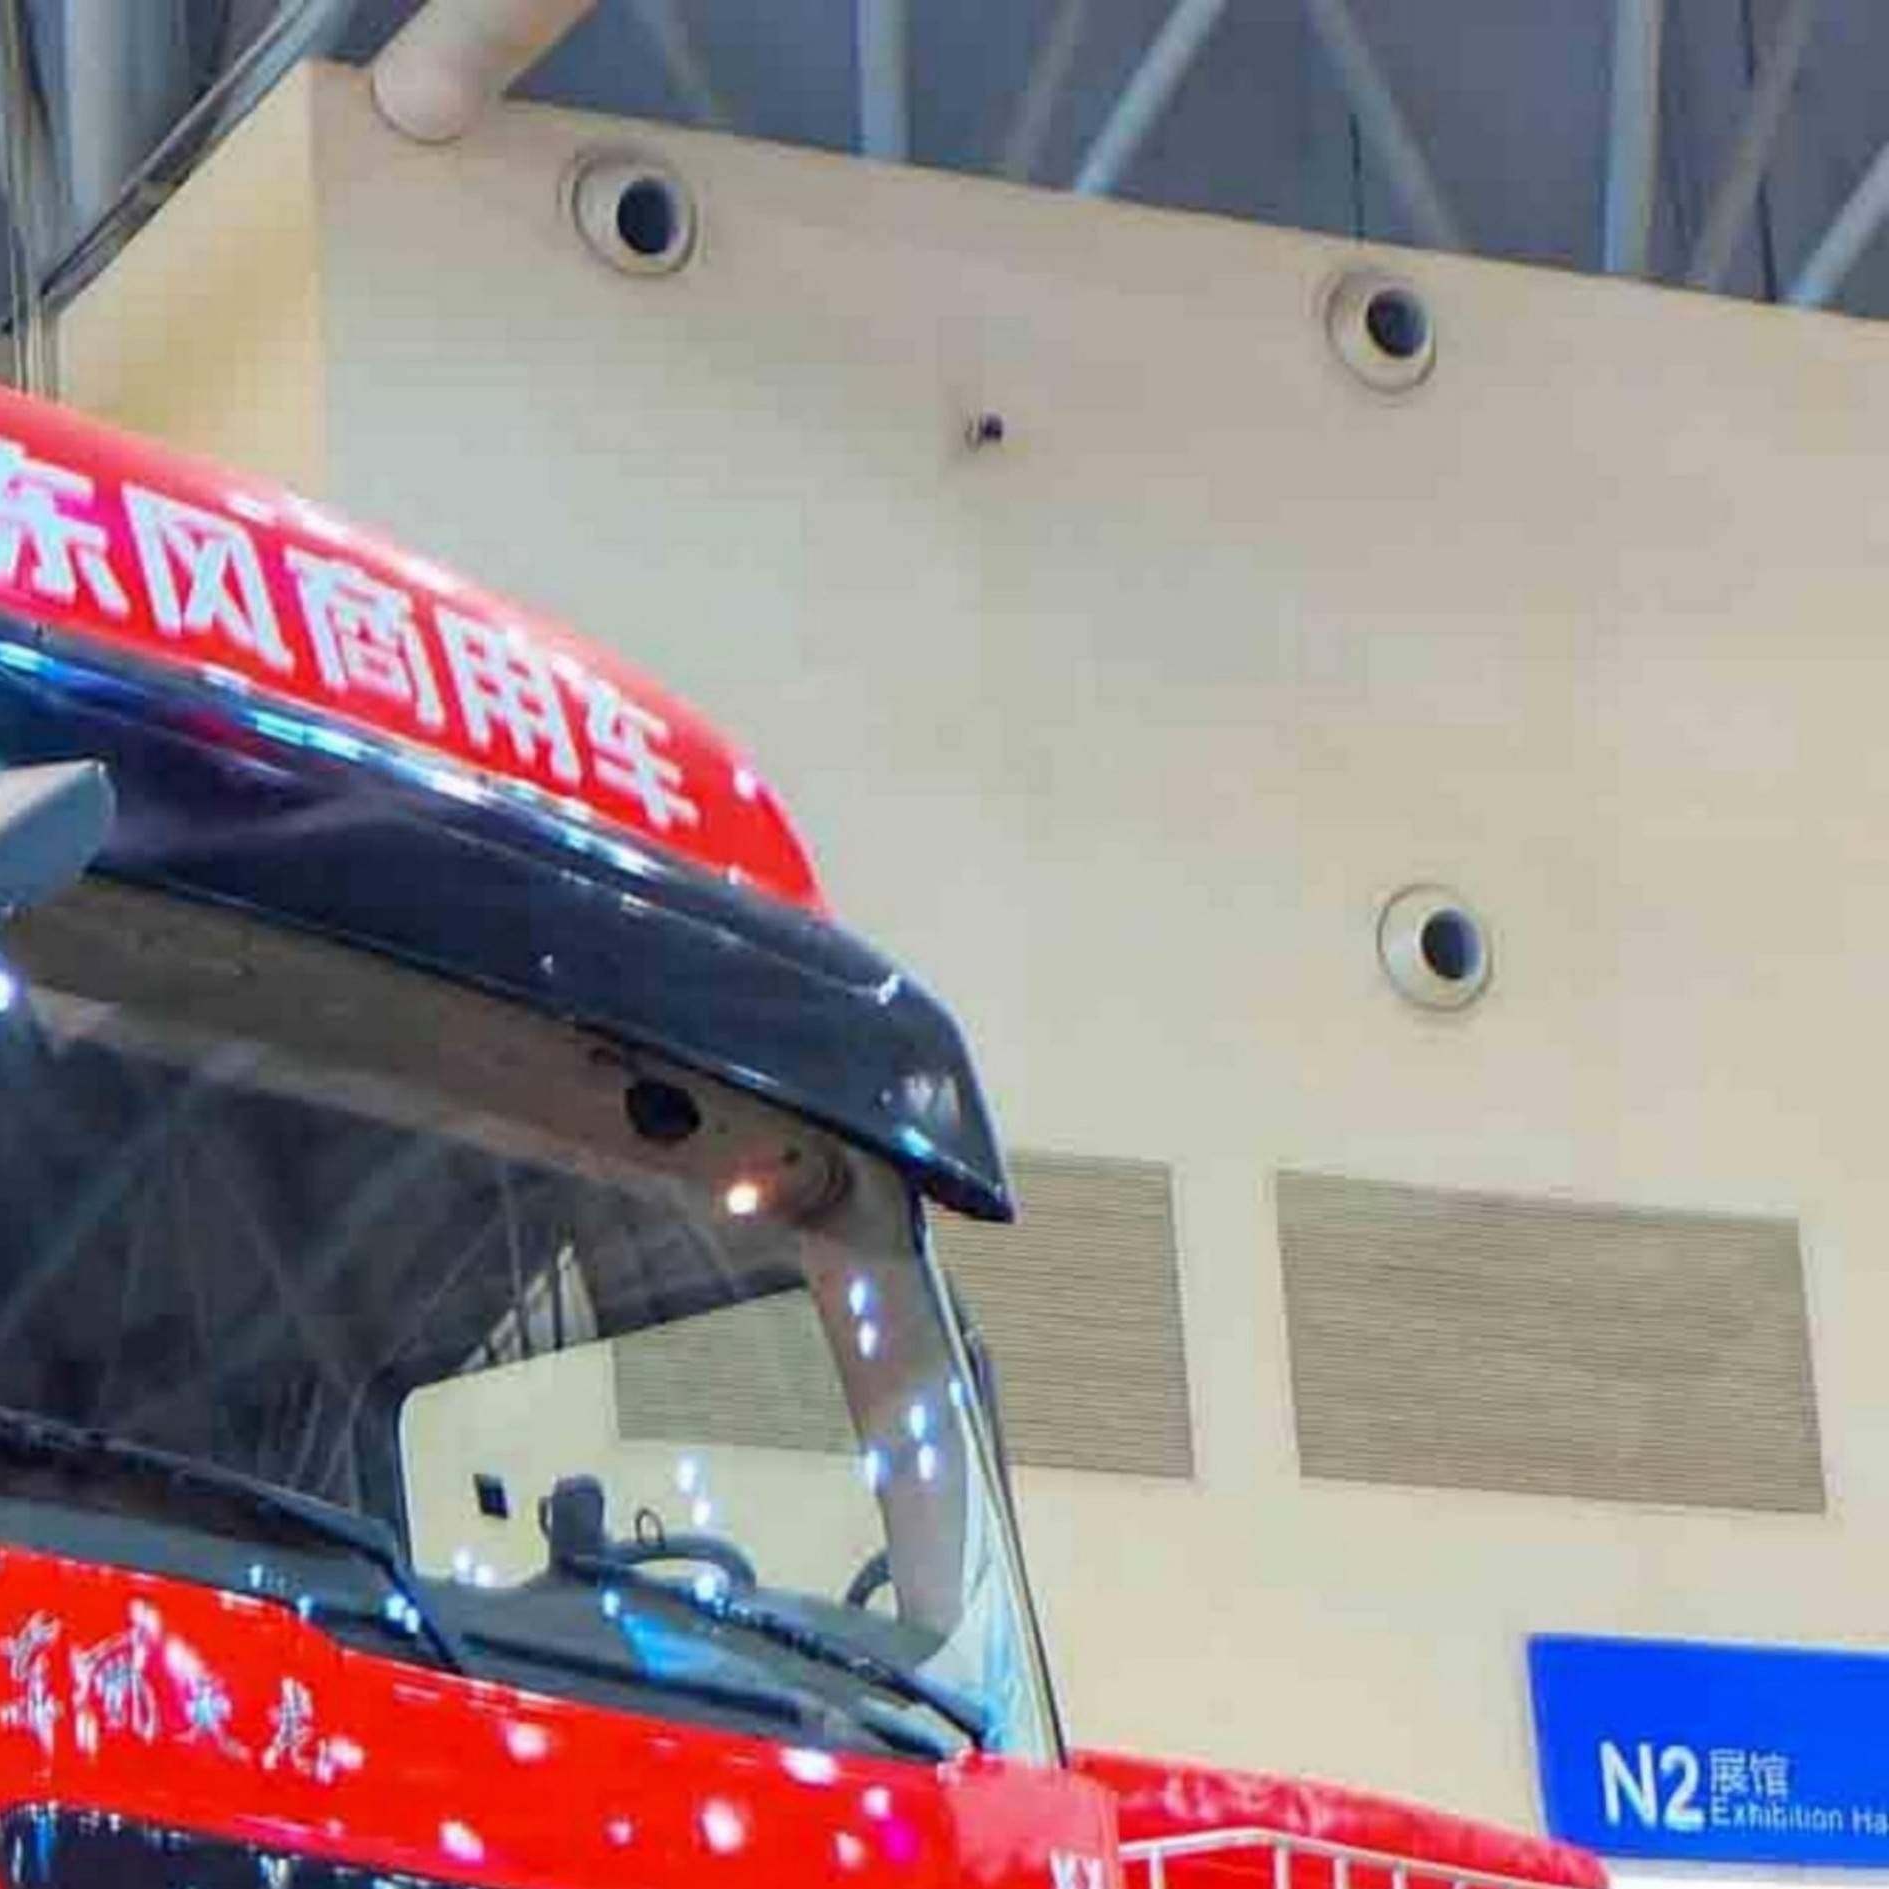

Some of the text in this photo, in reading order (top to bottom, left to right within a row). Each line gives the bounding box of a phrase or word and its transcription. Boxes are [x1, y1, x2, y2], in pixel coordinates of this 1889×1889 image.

[1599, 1740, 1790, 1833] N2 展馆
[1709, 1797, 1845, 1832] Exhibition
